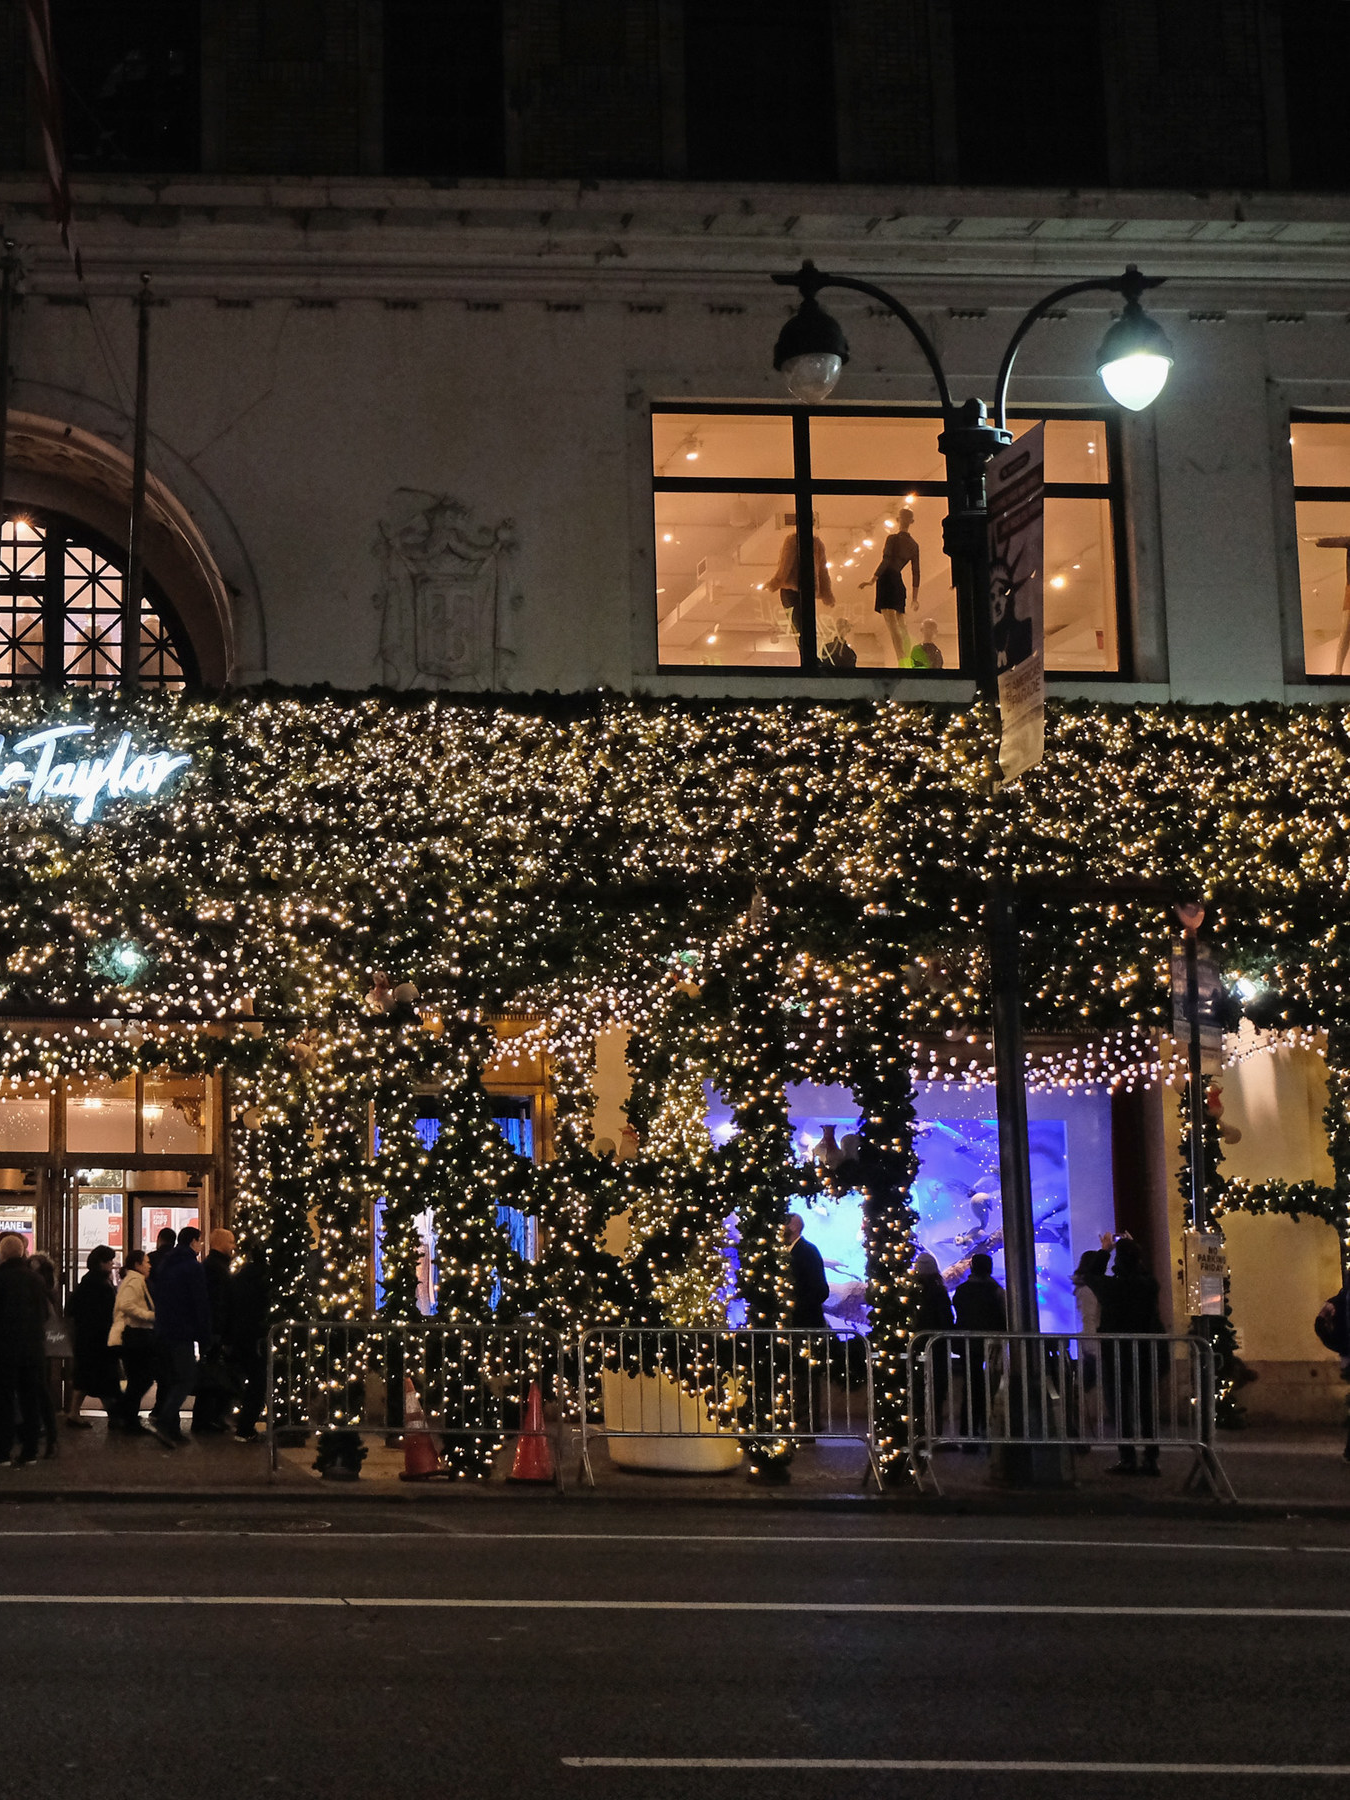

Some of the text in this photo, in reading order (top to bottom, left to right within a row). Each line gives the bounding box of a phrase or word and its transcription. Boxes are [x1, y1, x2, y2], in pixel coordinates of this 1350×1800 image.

[13, 725, 193, 825] Taylor
[1208, 1246, 1218, 1254] NO
[1197, 1254, 1226, 1264] PARKING
[1200, 1263, 1223, 1272] FRIDAY
